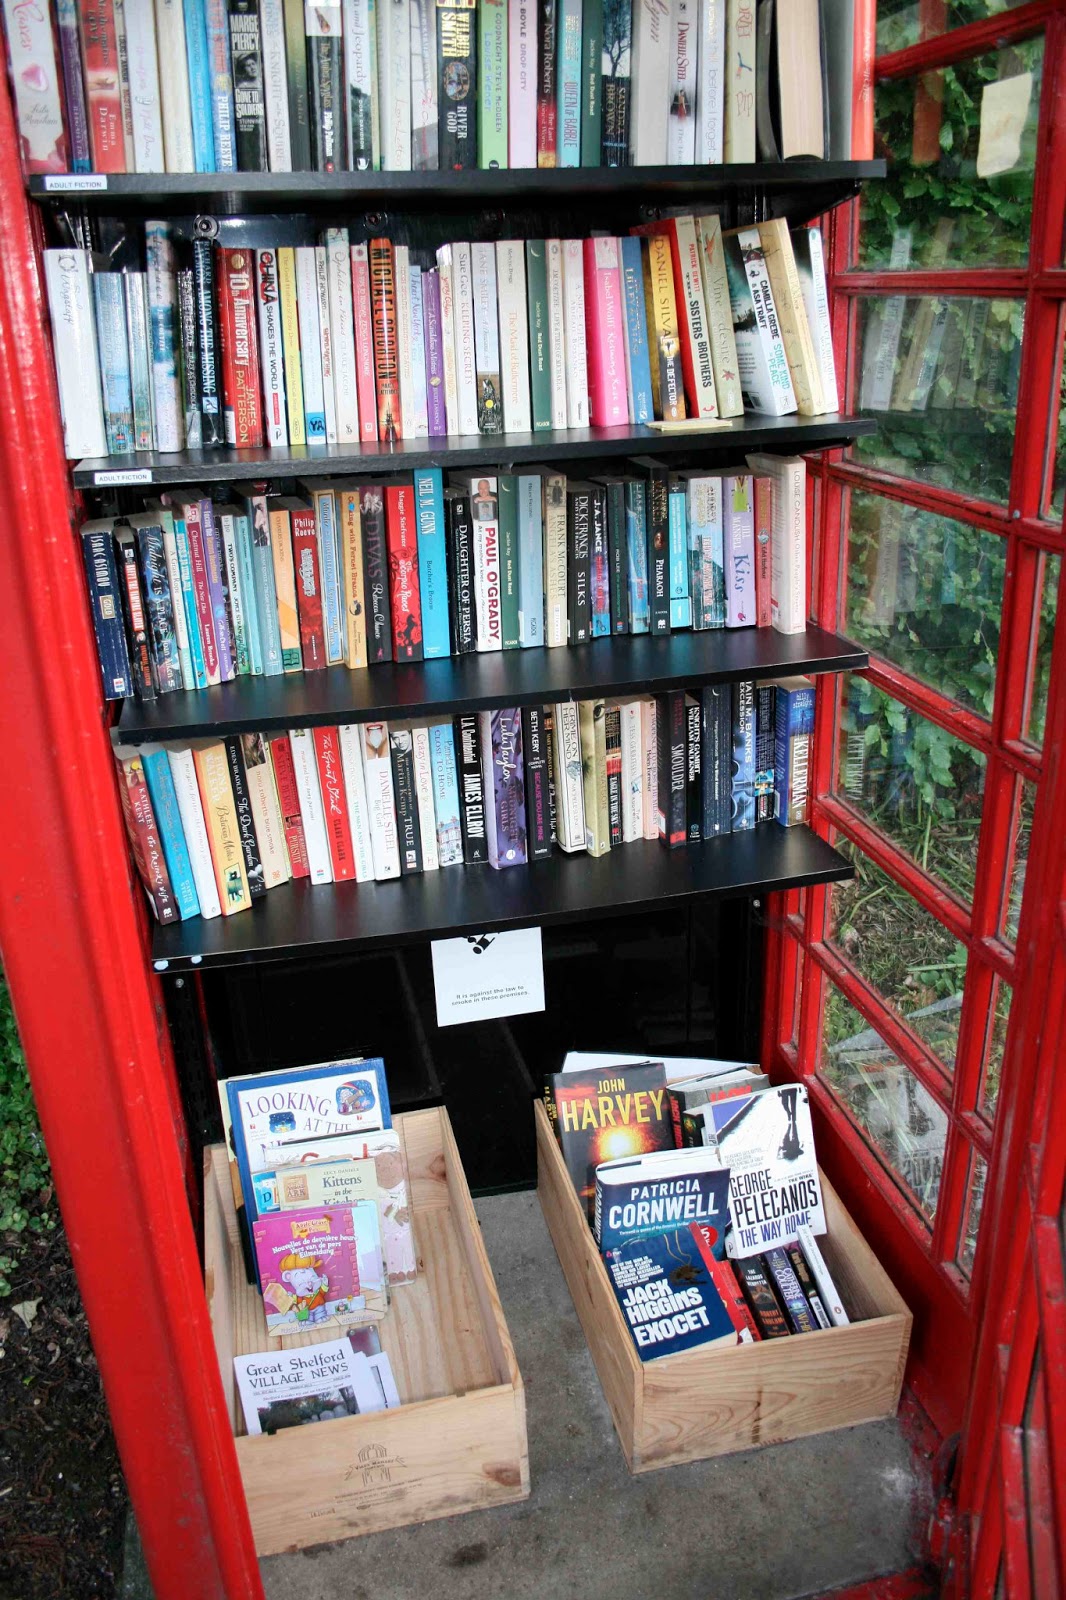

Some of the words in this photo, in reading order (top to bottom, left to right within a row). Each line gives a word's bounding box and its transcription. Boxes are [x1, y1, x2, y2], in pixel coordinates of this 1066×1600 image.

[230, 15, 259, 33] MARGE
[441, 12, 456, 57] SMITH
[456, 12, 470, 57] WILBUR
[543, 23, 553, 50] Nora
[231, 32, 261, 51] PIERCY
[484, 32, 493, 71] Louise
[677, 22, 689, 58] DANIELLE
[543, 53, 553, 94] Roberts
[484, 76, 493, 112] Wener
[564, 82, 578, 107] QUEEN
[218, 96, 229, 130] PHILIP
[236, 103, 264, 119] SOLDIERS
[322, 111, 333, 130] Philip
[447, 112, 457, 132] GOD
[457, 106, 467, 139] RIVER
[606, 84, 615, 136] BROWN
[99, 107, 109, 151] Darwin
[109, 114, 117, 146] Emma
[325, 131, 334, 156] Pullman
[564, 119, 578, 147] BABBLE
[221, 134, 232, 167] REEVE
[458, 253, 467, 273] Sue
[654, 239, 668, 293] DANIEL
[688, 243, 698, 268] PATRICK
[259, 252, 277, 305] CHINA
[372, 248, 394, 315] MICHAEL
[603, 272, 613, 299] Isabel
[197, 287, 211, 324] AMONG
[605, 301, 615, 328] Wolff
[659, 299, 671, 336] SILVA
[759, 280, 773, 313] CAMILLA
[767, 314, 780, 339] GREBE
[233, 297, 250, 367] Anniversary
[266, 306, 275, 338] SHAKES
[461, 302, 470, 344] KEEPING
[199, 328, 213, 349] THE
[268, 341, 276, 358] THE
[376, 319, 396, 380] CRICHTON
[689, 300, 703, 339] SISTERS
[697, 342, 712, 388] BROTHERS
[463, 346, 472, 385] SECRETS
[773, 344, 783, 368] SOME
[201, 351, 215, 393] MISSING
[269, 360, 278, 390] WORLD
[666, 368, 677, 406] DEFECTOR
[768, 358, 780, 386] PEACE
[777, 371, 790, 390] KIND
[236, 370, 248, 443] PATTERSON
[246, 386, 256, 427] JAMES
[418, 478, 433, 496] NEIL
[396, 490, 406, 515] Maggie
[578, 496, 588, 521] DICK
[399, 517, 408, 547] Stiefvater
[420, 511, 436, 535] GUNN
[557, 514, 565, 547] FRANK
[594, 520, 603, 552] JANCE
[732, 517, 742, 550] MANSELL
[741, 525, 751, 539] JILL
[90, 535, 106, 557] ISAAC
[191, 530, 201, 558] Chestnut
[365, 521, 382, 578] DIVAS
[459, 525, 469, 587] DAUGHTER
[485, 527, 497, 566] PAUL
[579, 523, 589, 559] FRANCIS
[94, 558, 110, 587] ASIMOV
[145, 531, 161, 584] Midnight
[228, 562, 238, 592] COMPANY
[656, 559, 665, 597] PHARAOH
[733, 554, 750, 592] Kiss
[372, 583, 383, 613] Rebecca
[461, 589, 470, 605] OF
[577, 572, 586, 606] SILKS
[103, 599, 113, 615] GOLD
[487, 571, 500, 639] O'GRADY
[204, 624, 213, 644] Lauren
[373, 613, 385, 639] Chance
[462, 607, 471, 644] PERSIA
[164, 657, 174, 678] Aiken
[207, 646, 215, 666] Brooke
[499, 718, 513, 745] Lulu
[530, 711, 538, 732] BETH
[569, 708, 577, 739] CRIME
[229, 746, 238, 764] EDEN
[323, 734, 332, 750] The
[531, 734, 539, 753] KERY
[564, 733, 572, 760] MIND
[571, 742, 577, 757] ON
[321, 750, 337, 780] Great
[396, 753, 406, 787] Martin
[495, 743, 516, 782] Taylor
[671, 743, 684, 793] SMOULDER
[792, 741, 808, 809] KELLERMAN
[234, 765, 243, 795] BRADLEY
[463, 773, 482, 802] JAMES
[138, 788, 155, 830] KATHLEEN
[237, 798, 249, 813] The
[326, 781, 342, 816] Stink
[379, 771, 392, 820] DANIELLE
[399, 788, 408, 816] Kemp
[133, 801, 145, 824] KENT
[239, 815, 251, 839] Dark
[466, 805, 484, 838] ELLROY
[384, 822, 395, 853] STEEL
[404, 816, 414, 847] TRUE
[242, 839, 255, 867] Garden
[470, 990, 492, 998] against
[500, 991, 529, 999] premises.
[597, 1077, 625, 1094] JOHN
[245, 1092, 333, 1118] LOOKING
[561, 1089, 664, 1133] HARVEY
[304, 1117, 319, 1132] AT
[322, 1175, 362, 1188] Kittens
[630, 1179, 701, 1201] PATRICIA
[729, 1168, 774, 1198] GEORGE
[609, 1192, 719, 1229] CORNWELL
[733, 1180, 819, 1228] PELECANOS
[272, 1241, 302, 1254] Nouvelles
[739, 1226, 759, 1249] THE
[759, 1221, 782, 1243] WAY
[622, 1278, 672, 1308] JACK
[626, 1287, 703, 1326] HIGGINS
[633, 1306, 710, 1347] EXOCET
[246, 1362, 283, 1377] Great
[289, 1349, 345, 1370] Shelford
[248, 1372, 305, 1389] VILLAGE
[311, 1362, 349, 1379] NEWS
